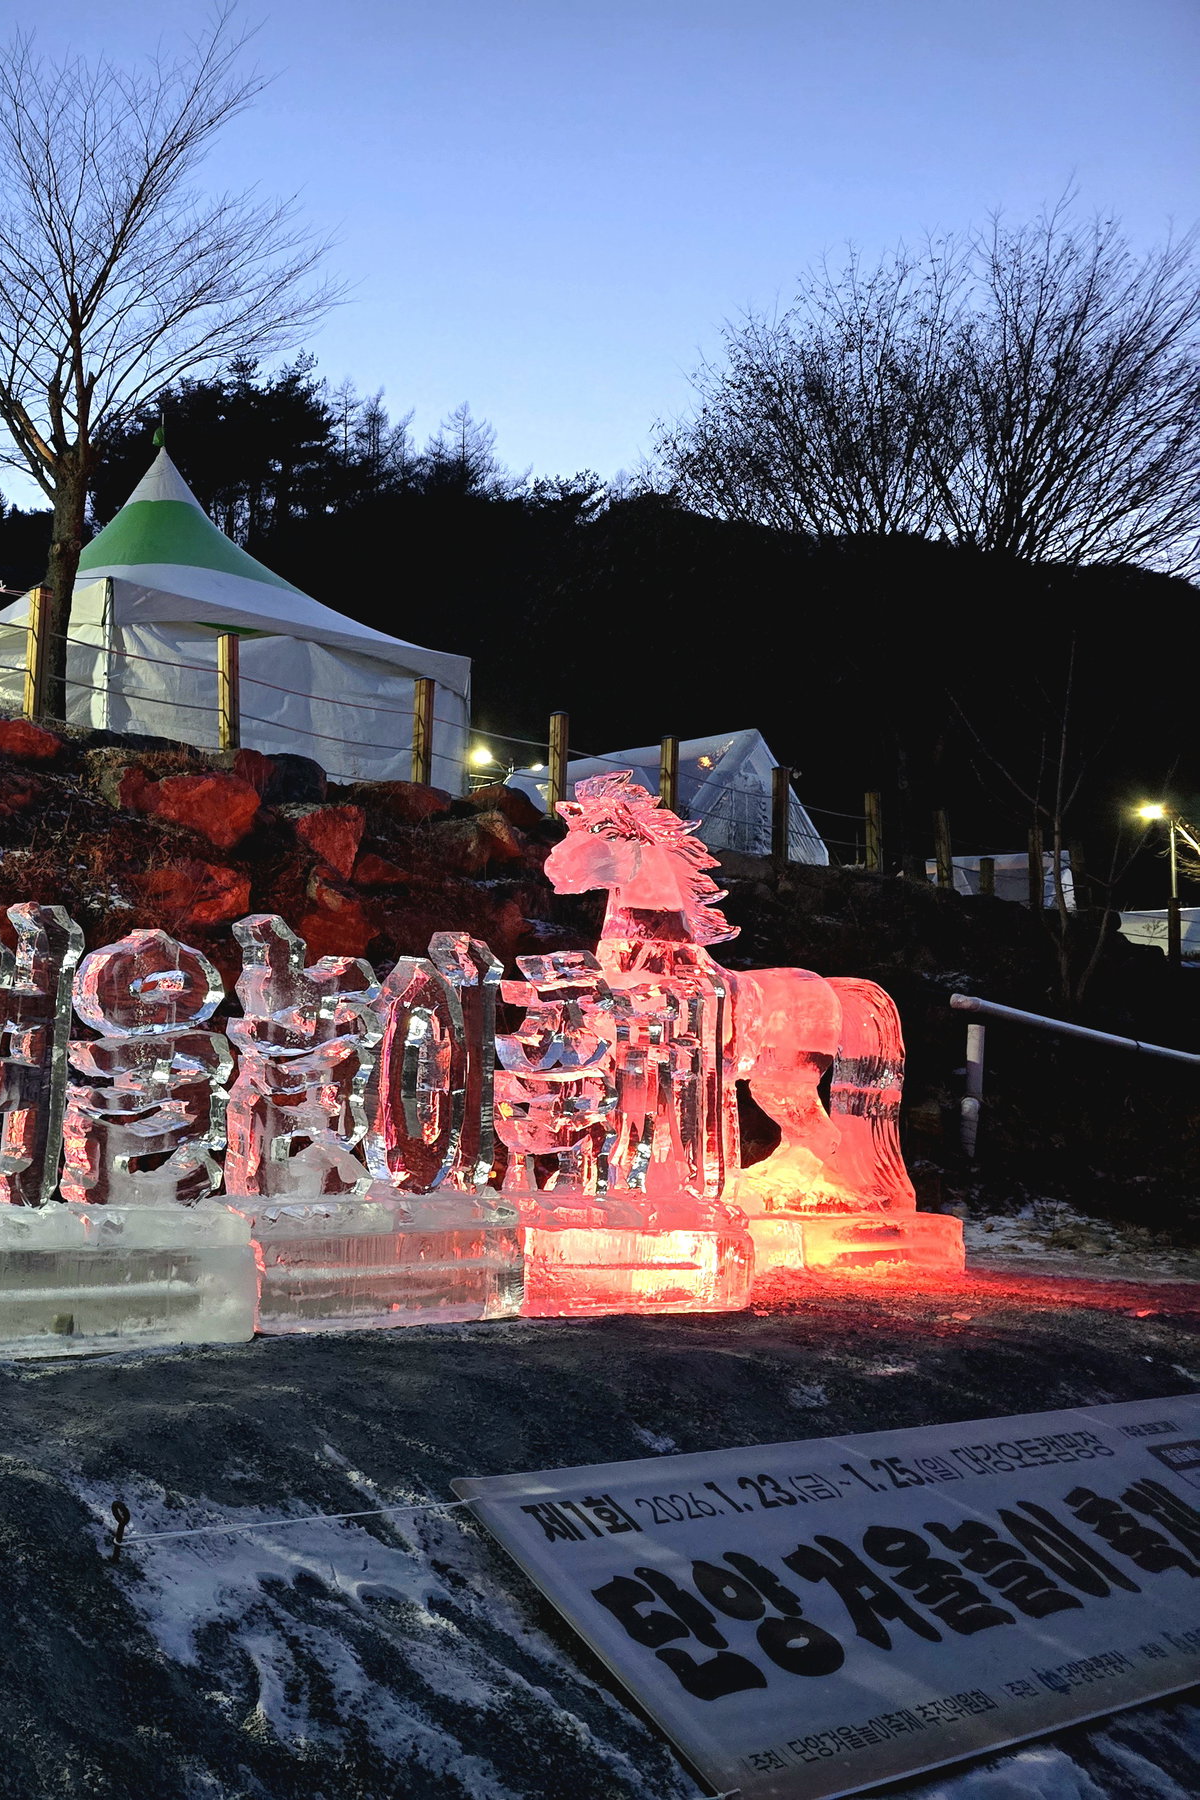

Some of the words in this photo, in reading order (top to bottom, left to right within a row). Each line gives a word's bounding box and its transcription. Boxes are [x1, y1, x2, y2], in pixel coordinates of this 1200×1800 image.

[520, 1494, 644, 1543] 제1회
[590, 1551, 846, 1702] 단양
[780, 1500, 1143, 1651] 겨울놀이
[748, 1748, 789, 1773] 주최
